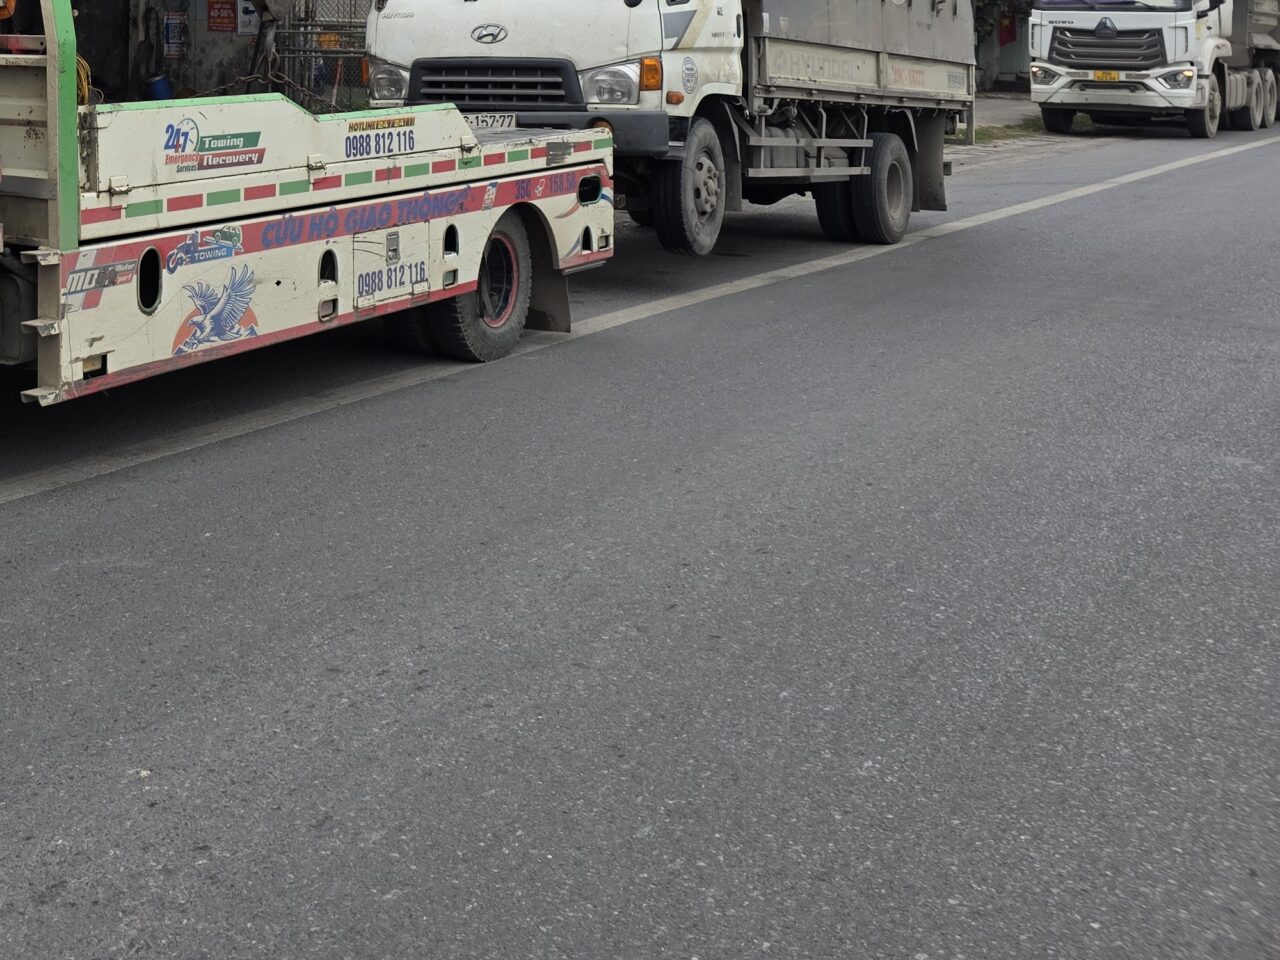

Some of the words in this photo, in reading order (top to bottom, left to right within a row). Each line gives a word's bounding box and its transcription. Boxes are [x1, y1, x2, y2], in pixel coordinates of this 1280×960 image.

[348, 120, 376, 132] HOTLINE
[202, 136, 244, 148] Towing
[345, 133, 371, 158] 0988
[374, 131, 394, 155] 812
[396, 129, 415, 152] 116
[165, 153, 200, 166] Emergency
[202, 152, 259, 166] Recovery
[344, 202, 392, 234] GIAO
[194, 247, 228, 260] TOWING
[358, 269, 384, 297] 0988
[386, 264, 405, 290] 812
[408, 260, 426, 284] 116
